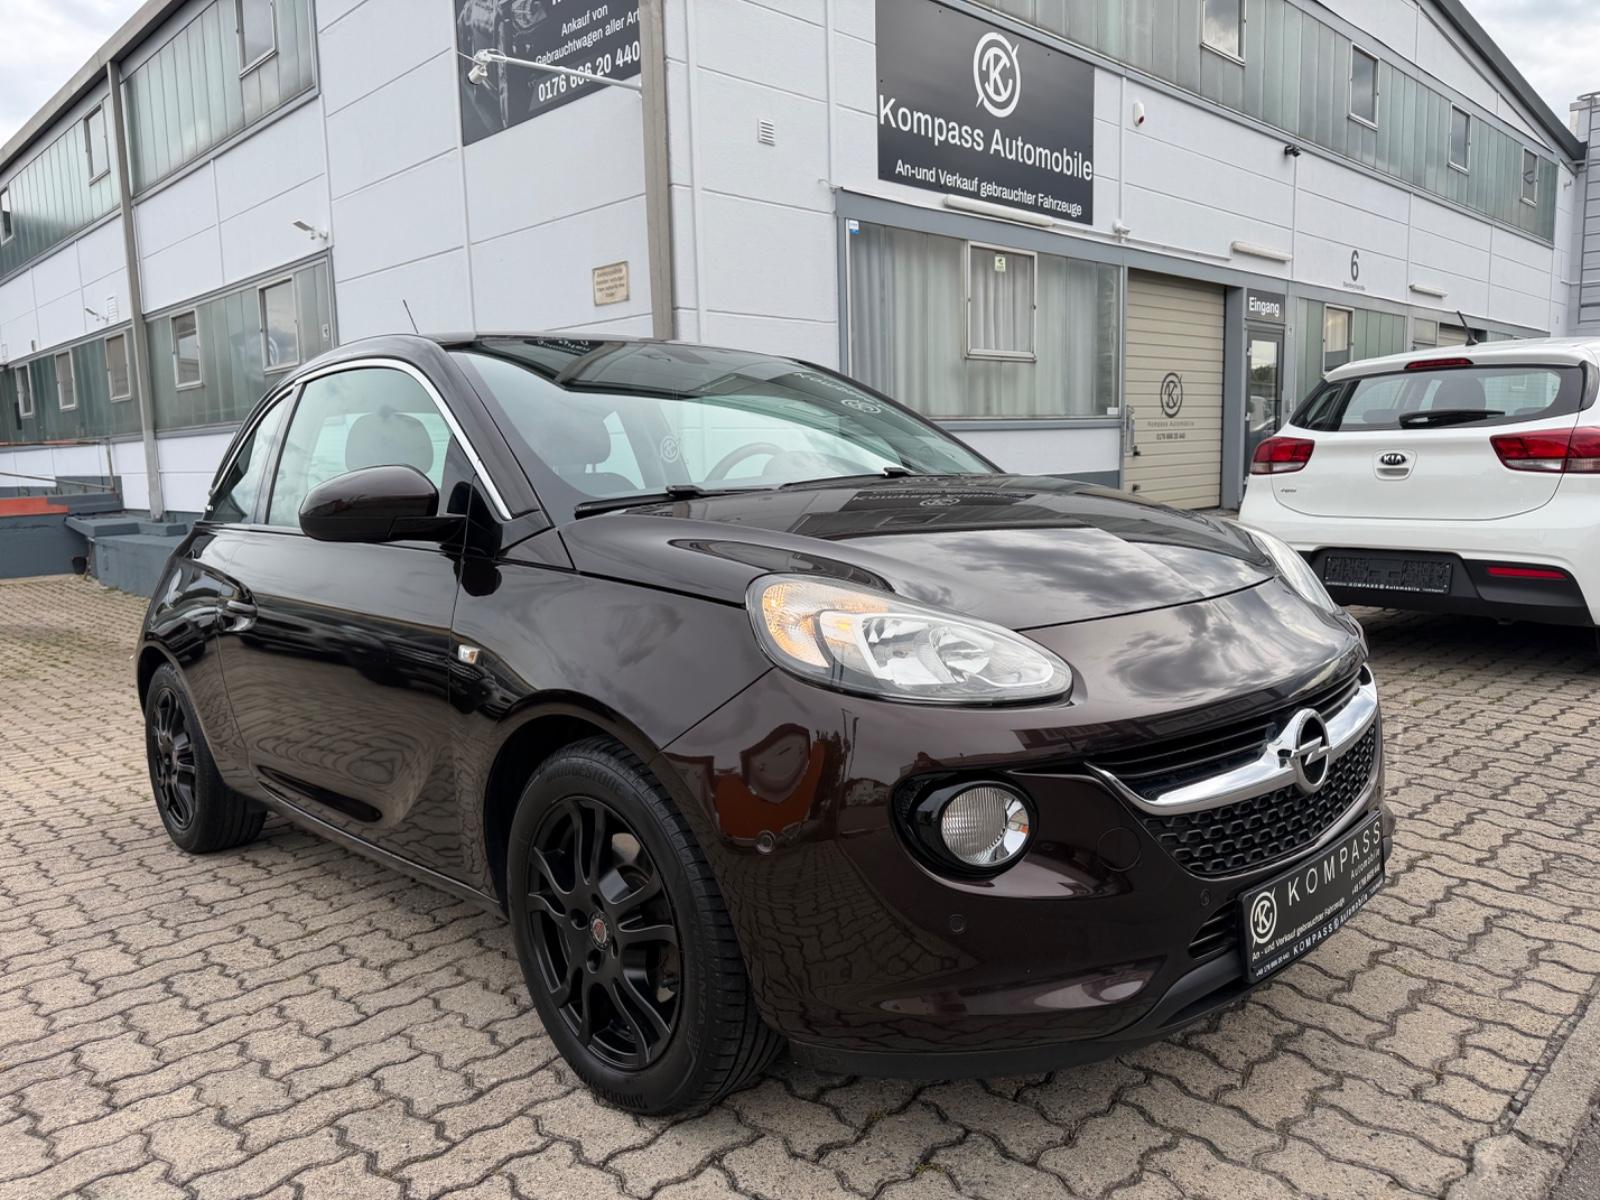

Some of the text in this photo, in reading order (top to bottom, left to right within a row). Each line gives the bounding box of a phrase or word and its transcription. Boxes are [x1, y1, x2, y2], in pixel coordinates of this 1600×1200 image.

[536, 8, 640, 65] Gebrauchtwagen aller Art
[561, 5, 608, 37] Ankauf von
[538, 74, 567, 102] 0176
[596, 54, 612, 76] 20
[615, 41, 640, 68] 440
[879, 95, 1093, 181] Kompass Automobile
[895, 159, 1083, 217] An-und Verkauf gebrauchter Fahrzeuge
[1350, 250, 1360, 282] 6
[1249, 297, 1281, 318] Eingang
[1383, 454, 1403, 465] KIA
[1288, 821, 1380, 907] KOMPASS
[1293, 923, 1333, 956] KOMPASS
